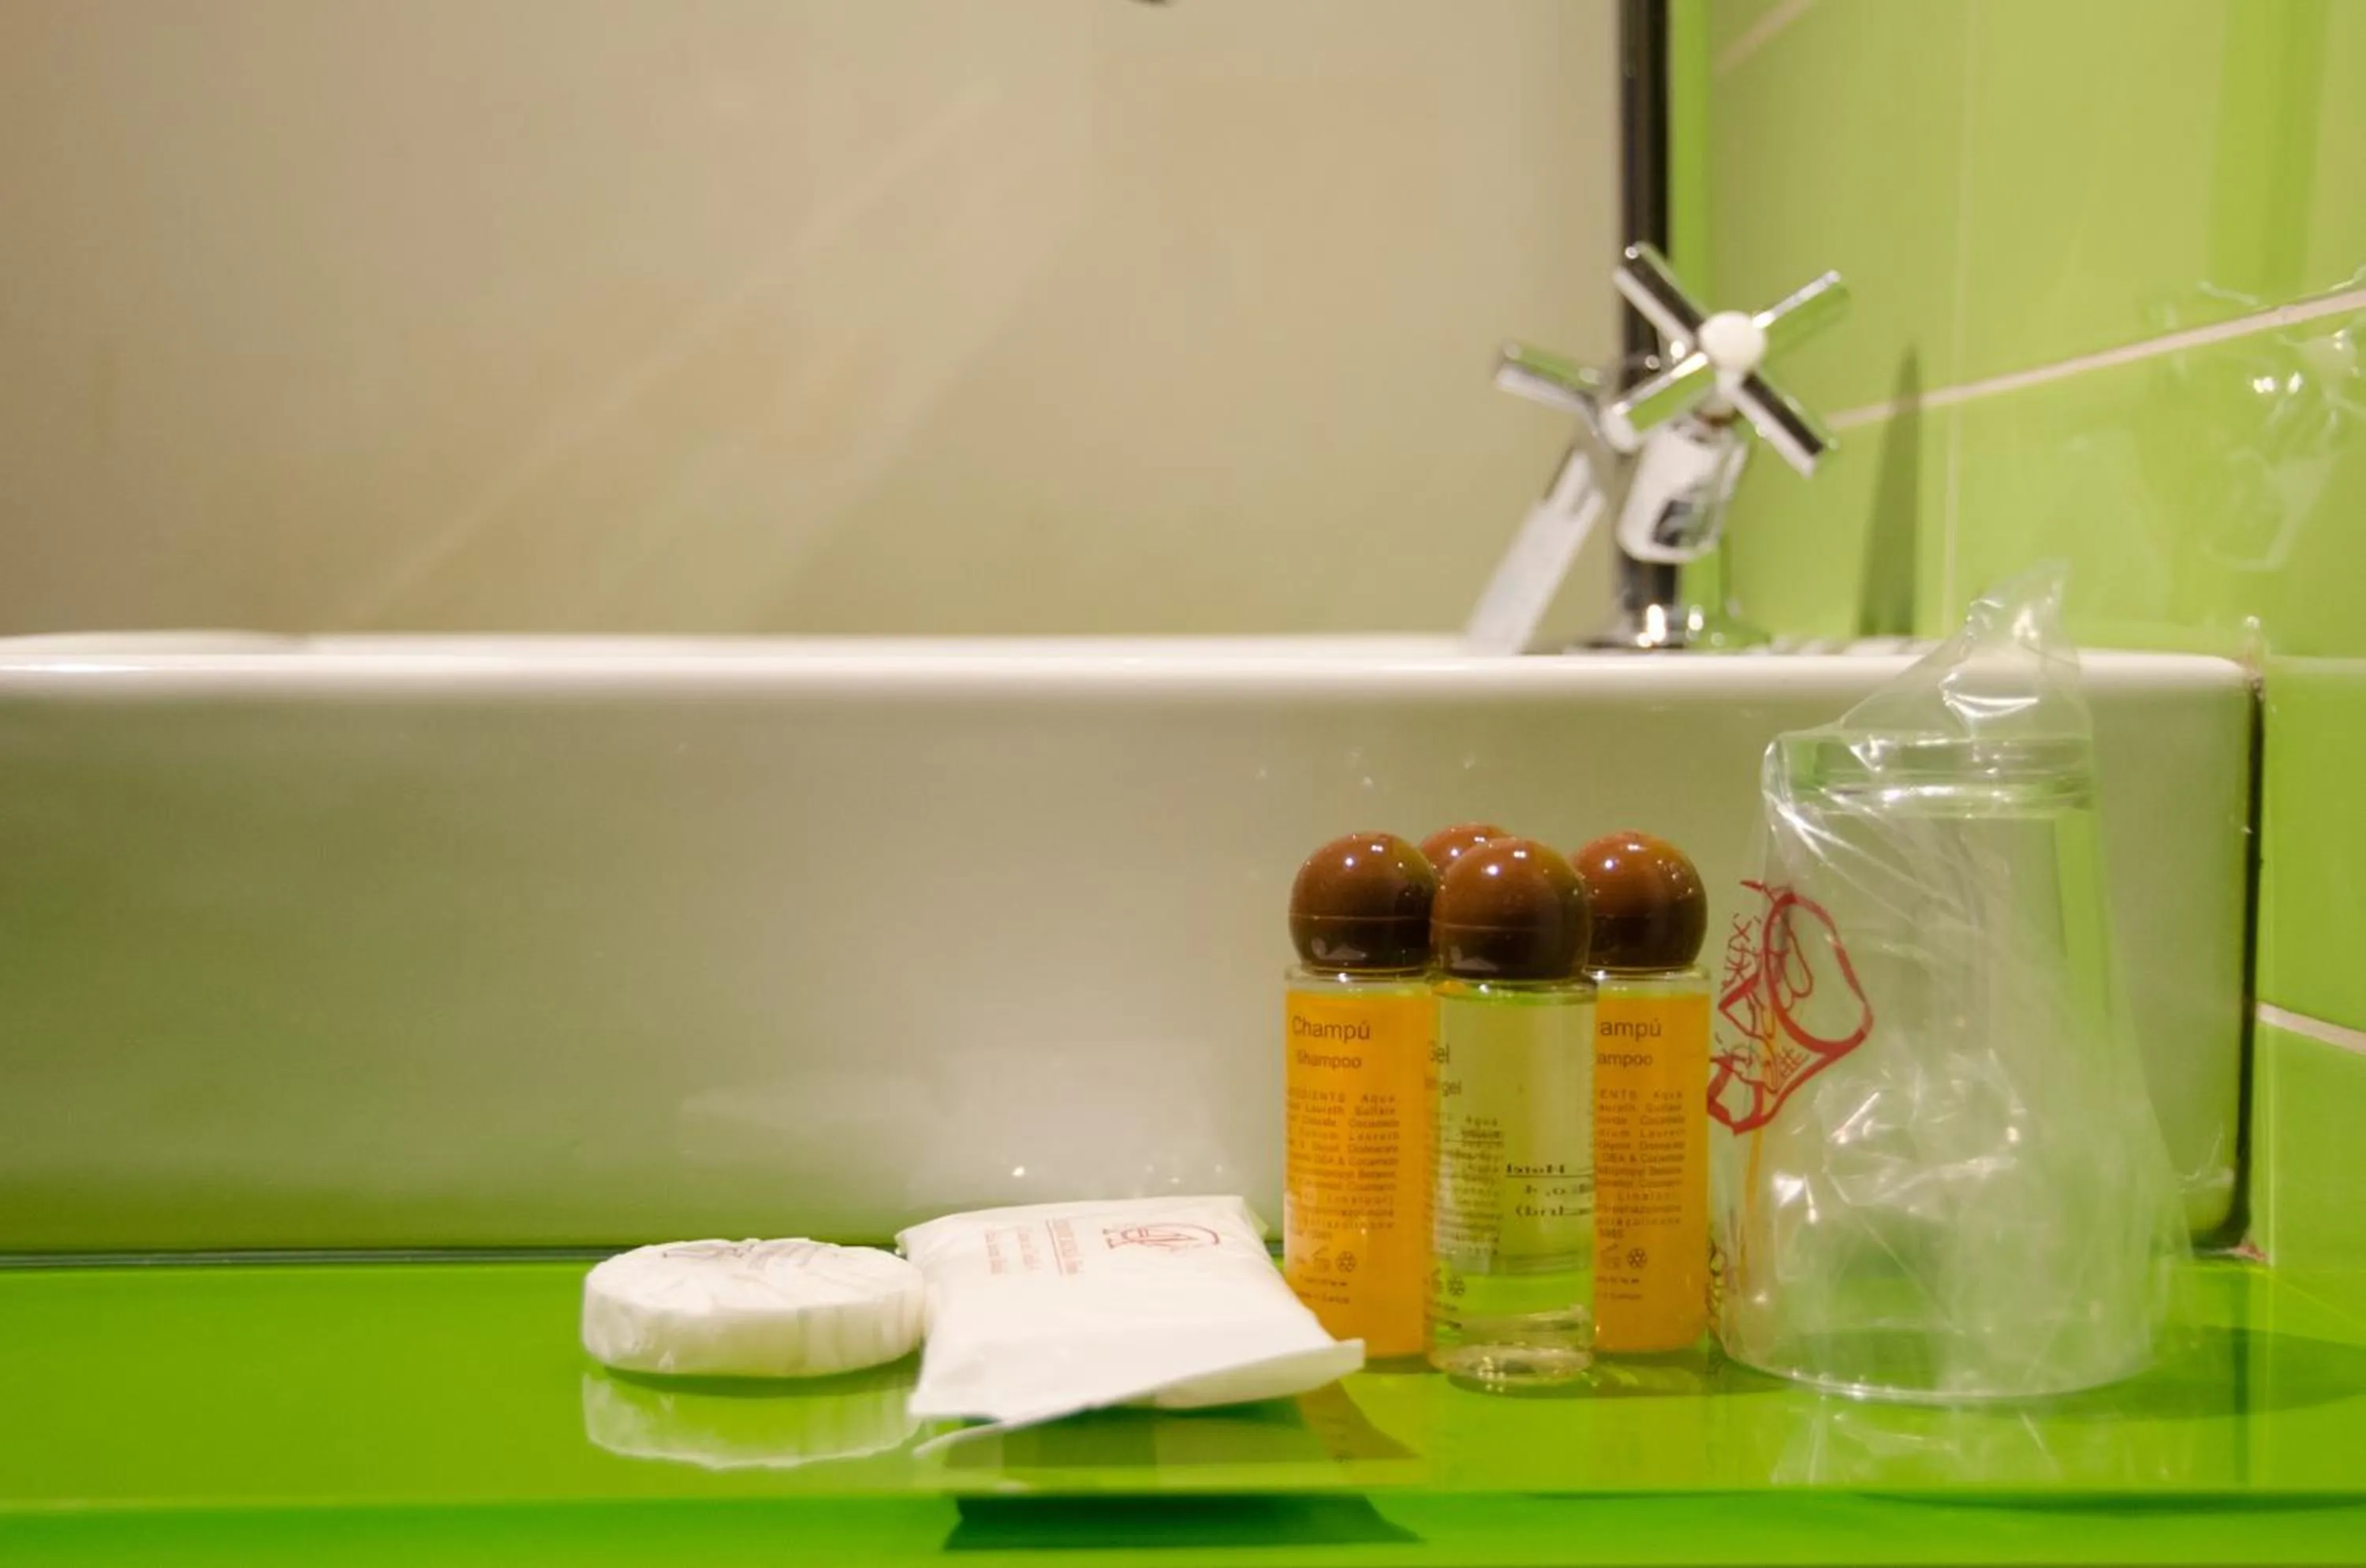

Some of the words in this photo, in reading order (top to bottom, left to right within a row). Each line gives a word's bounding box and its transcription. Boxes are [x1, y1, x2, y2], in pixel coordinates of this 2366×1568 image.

[1291, 1014, 1371, 1044] Champú
[1599, 1016, 1662, 1043] ampú
[1597, 1052, 1655, 1068] ampoo
